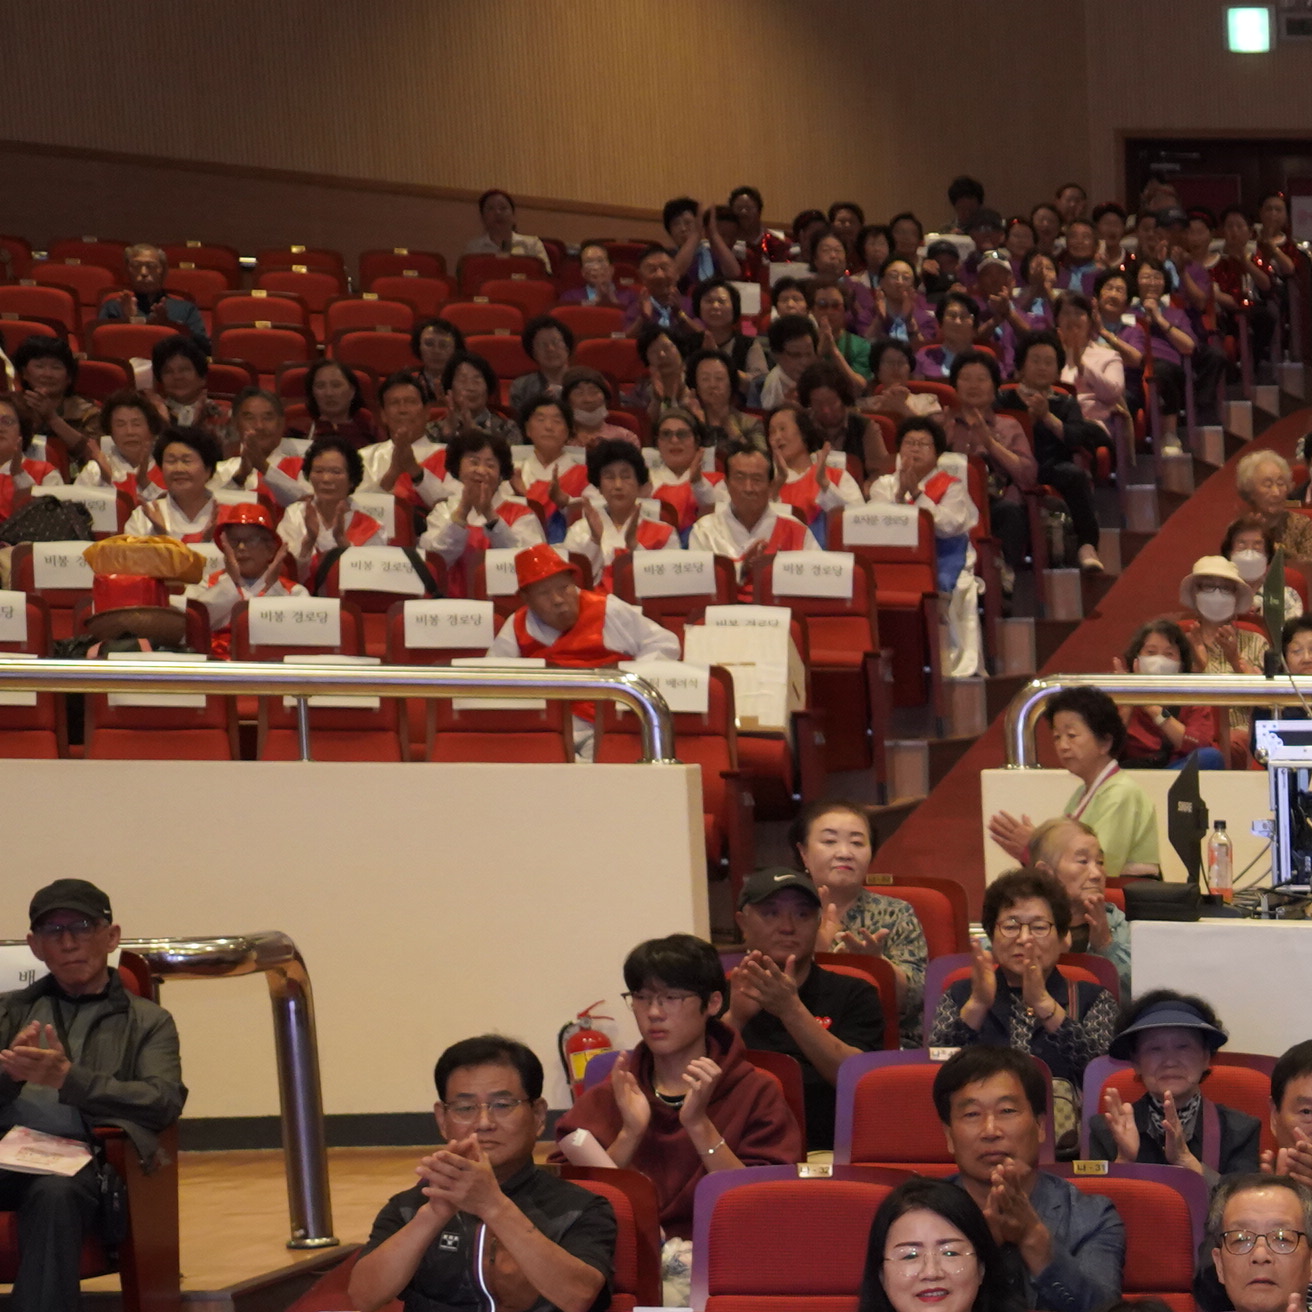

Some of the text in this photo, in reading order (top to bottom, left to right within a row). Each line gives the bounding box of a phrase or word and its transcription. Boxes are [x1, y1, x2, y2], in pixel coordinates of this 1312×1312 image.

[644, 562, 704, 575] 비봉 경로당
[783, 564, 843, 576] 비봉 경로당
[260, 610, 328, 624] 비봉 경로당
[416, 613, 482, 626] 비봉 경로당
